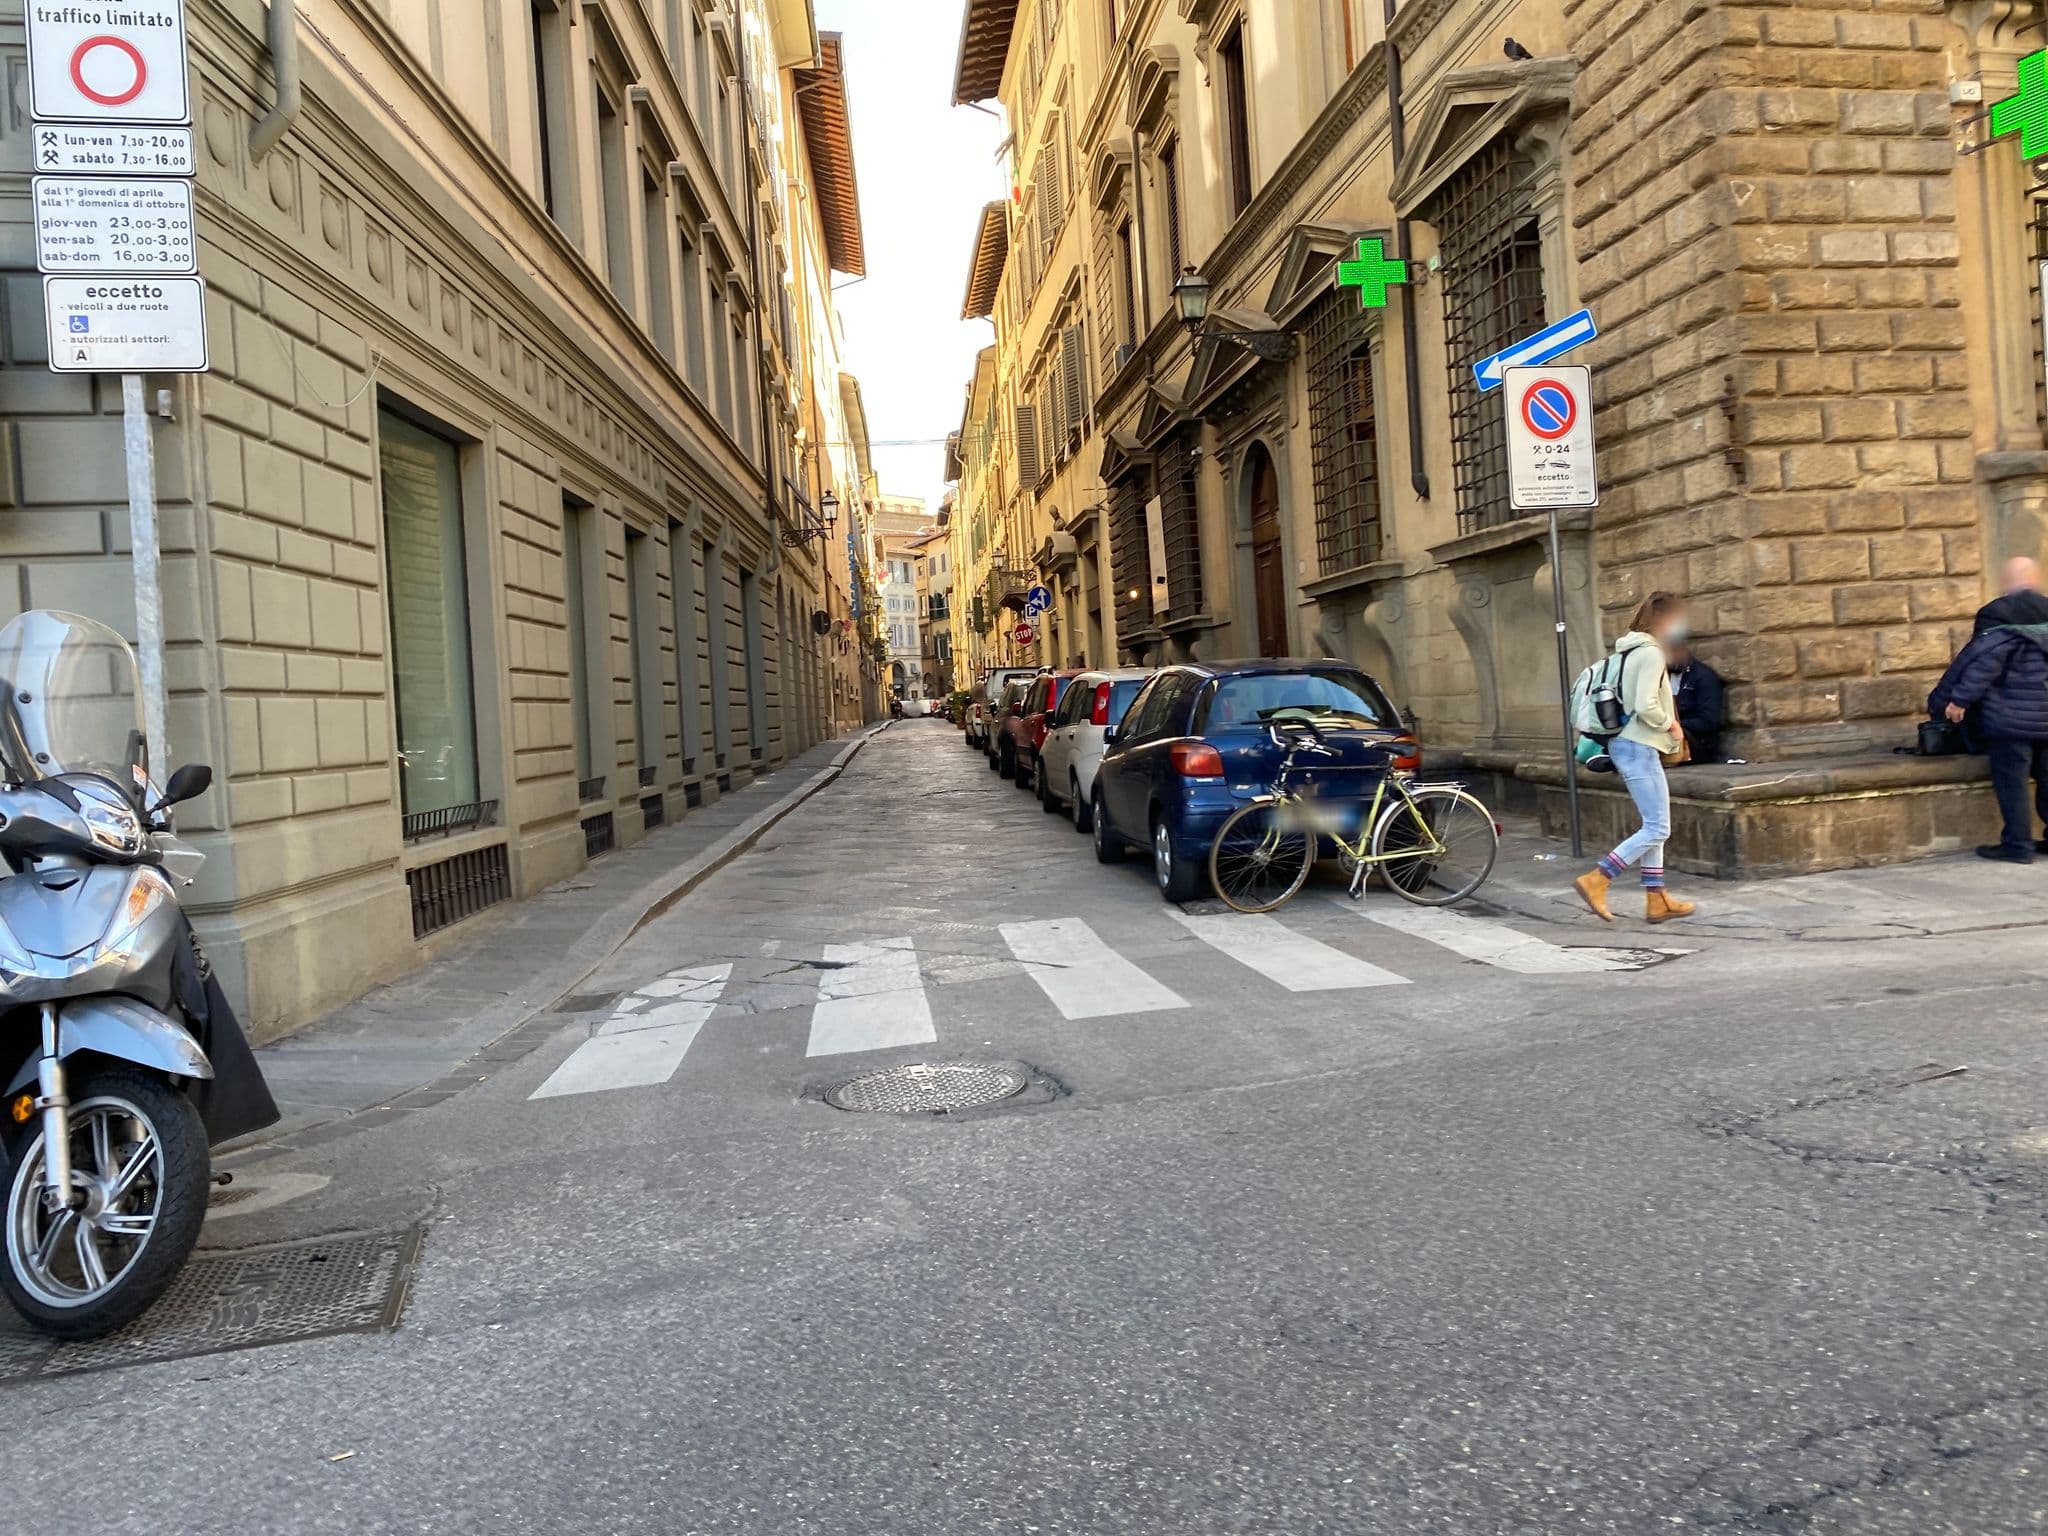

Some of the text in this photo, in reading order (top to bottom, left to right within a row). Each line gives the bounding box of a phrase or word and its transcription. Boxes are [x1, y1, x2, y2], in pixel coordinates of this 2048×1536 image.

[37, 7, 173, 27] traffico limitato
[64, 133, 113, 146] lun-ven
[72, 152, 114, 164] sabato
[43, 187, 61, 196] dal
[119, 188, 130, 197] di
[132, 188, 164, 198] aprile
[41, 198, 62, 207] alla
[78, 199, 130, 208] domenica
[133, 199, 143, 208] di
[146, 200, 186, 209] ottobre
[41, 218, 98, 230] giov-ven
[43, 234, 94, 245] ven-sab
[44, 251, 101, 262] sab-dom
[85, 284, 163, 299] eccetto
[67, 302, 103, 311] veicoli
[116, 303, 137, 311] due
[140, 303, 169, 311] ruote
[70, 335, 128, 344] autorizzati
[76, 349, 87, 361] A
[1545, 444, 1570, 454] 0-24
[1537, 473, 1570, 481] eccetto
[1015, 628, 1032, 640] STOP
